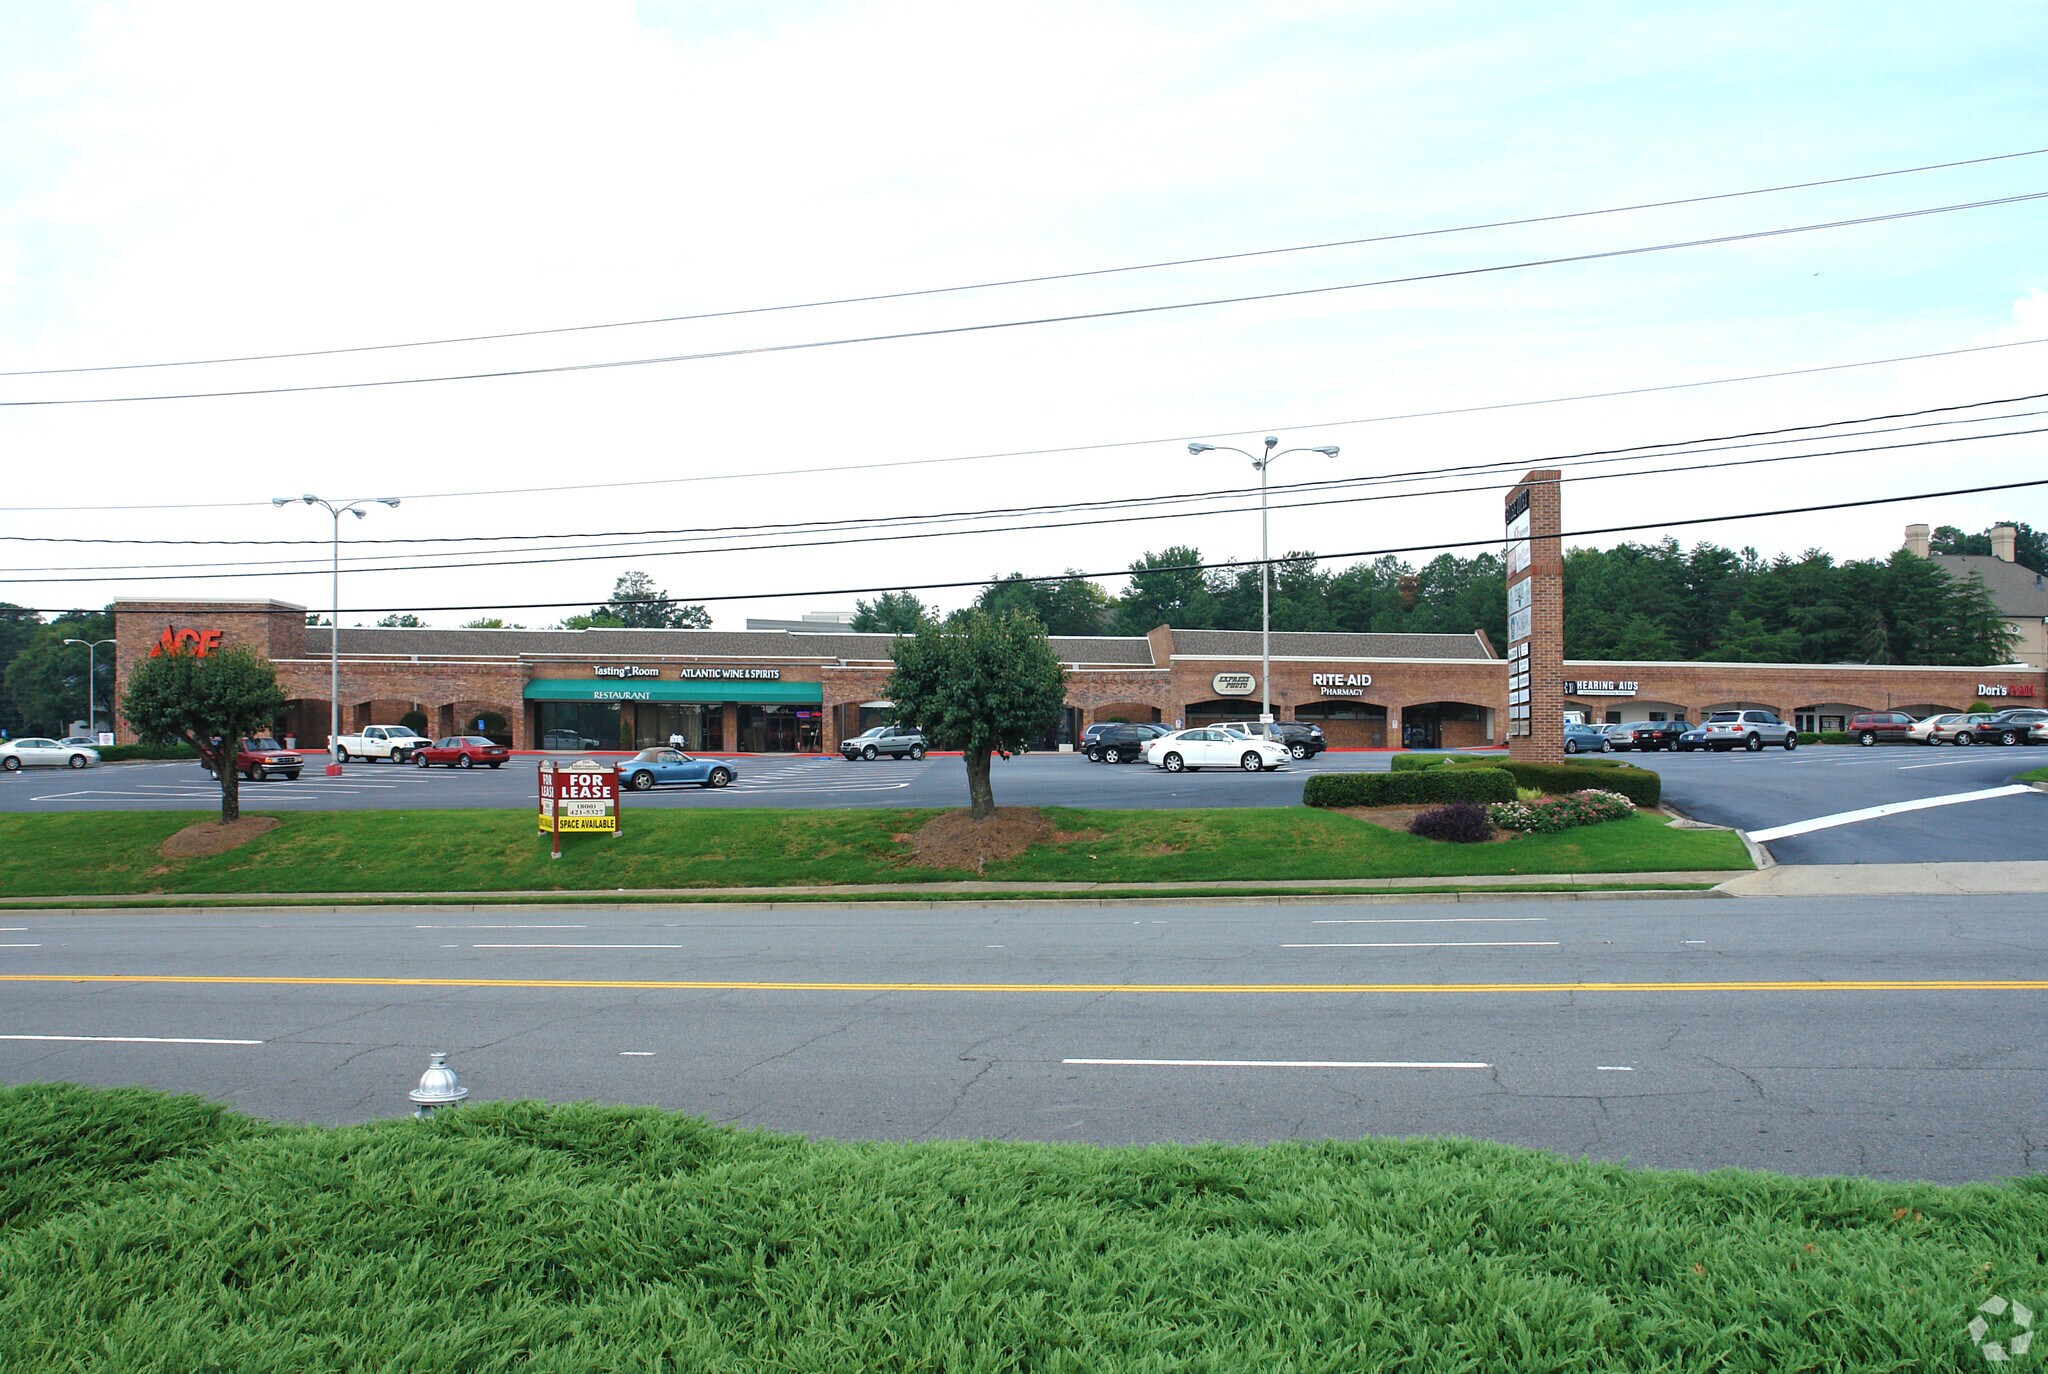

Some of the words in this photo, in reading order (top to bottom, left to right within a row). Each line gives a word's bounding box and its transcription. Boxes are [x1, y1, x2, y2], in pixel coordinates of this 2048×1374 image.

[149, 625, 221, 658] ACE
[593, 666, 625, 677] Tasting
[632, 666, 659, 676] Room
[680, 668, 721, 678] ATLANTIC
[722, 669, 744, 678] WINE
[745, 670, 750, 678] &
[750, 669, 780, 679] SPIRITS
[1312, 673, 1344, 686] RITE
[1347, 674, 1372, 686] AID
[1320, 686, 1364, 696] PHARMACY
[1577, 680, 1614, 690] HEARING
[1618, 680, 1639, 691] AIDS
[1977, 684, 2008, 696] Dori's
[593, 691, 651, 700] RESTAURANT
[569, 774, 604, 787] FOR
[561, 786, 612, 799] LEASE
[559, 819, 580, 830] SPACE
[580, 819, 615, 830] AVAILABLE
